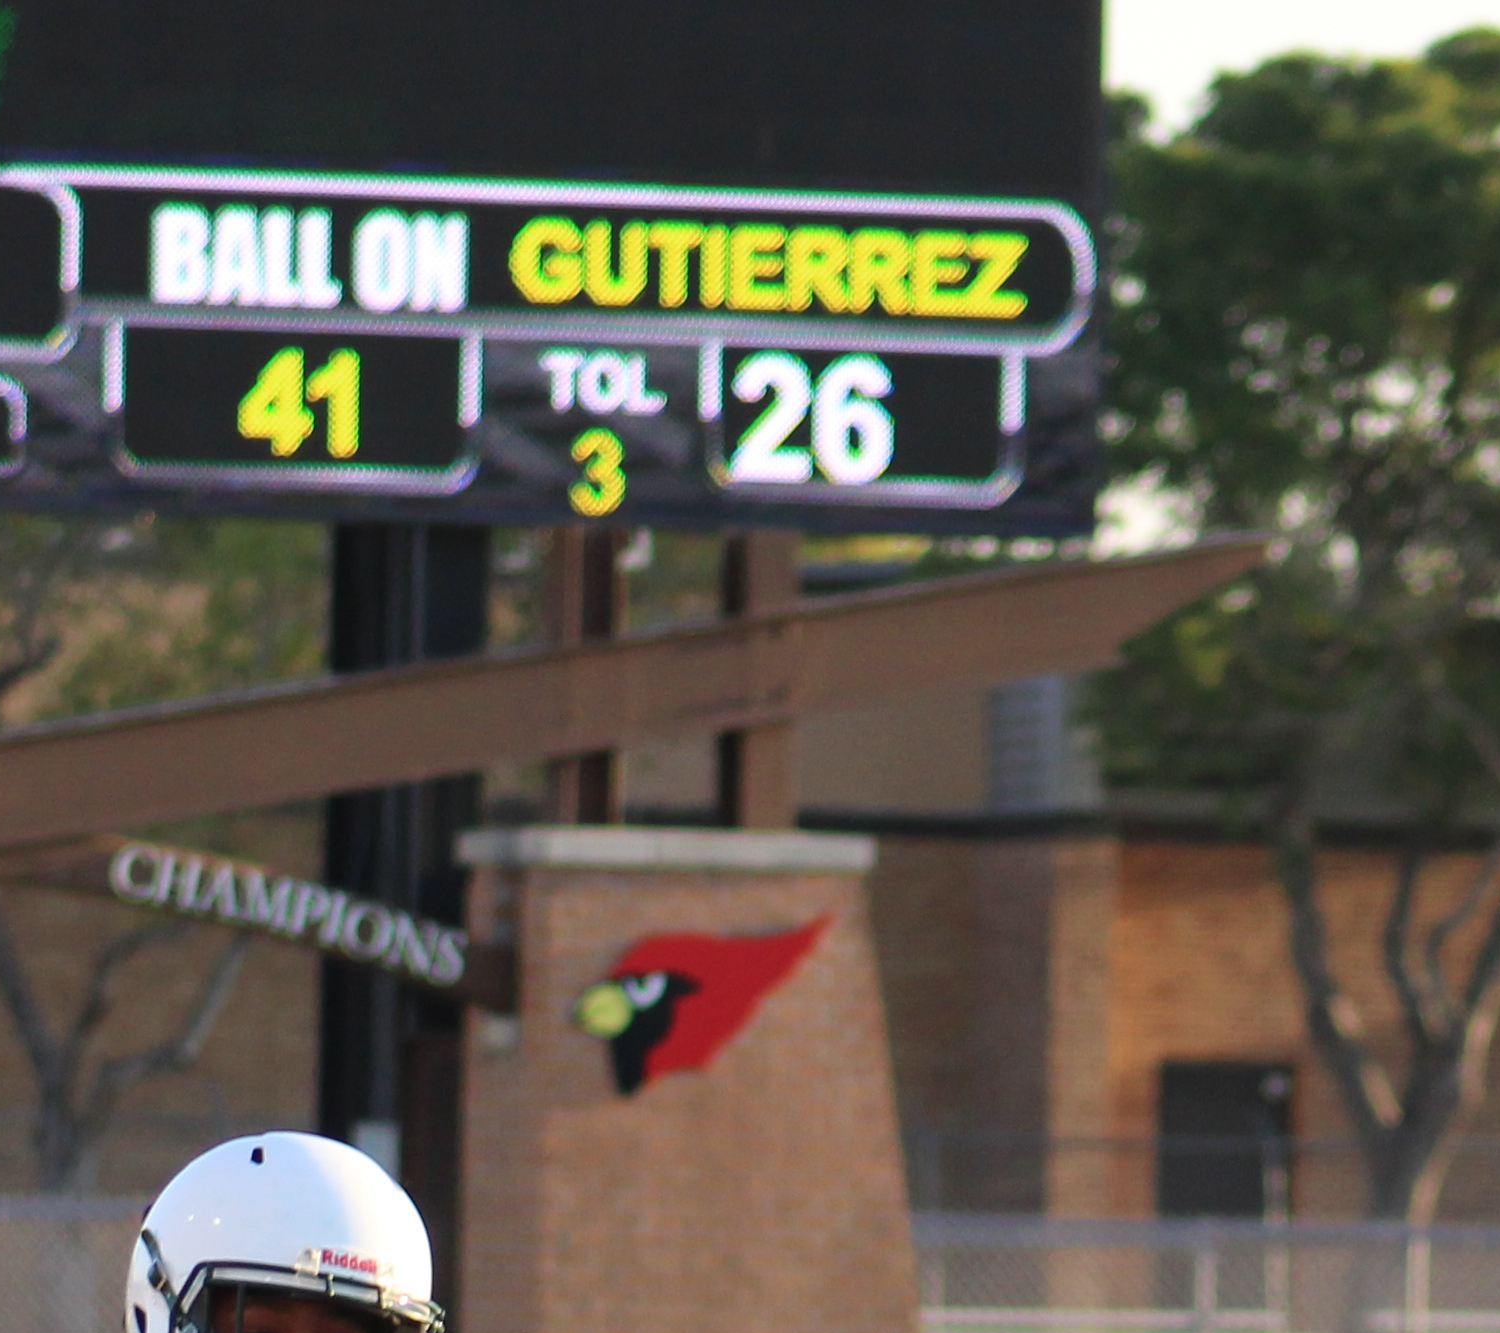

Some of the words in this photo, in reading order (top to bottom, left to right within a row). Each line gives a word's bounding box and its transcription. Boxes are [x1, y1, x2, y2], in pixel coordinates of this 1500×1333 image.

[151, 204, 341, 312] BALL
[350, 211, 469, 314] ON
[510, 219, 1029, 319] GUTIERREZ
[238, 347, 360, 459] 41
[540, 351, 666, 417] TOL
[730, 354, 894, 485] 26
[568, 429, 626, 517] 3
[111, 844, 467, 988] CHAMPIONS
